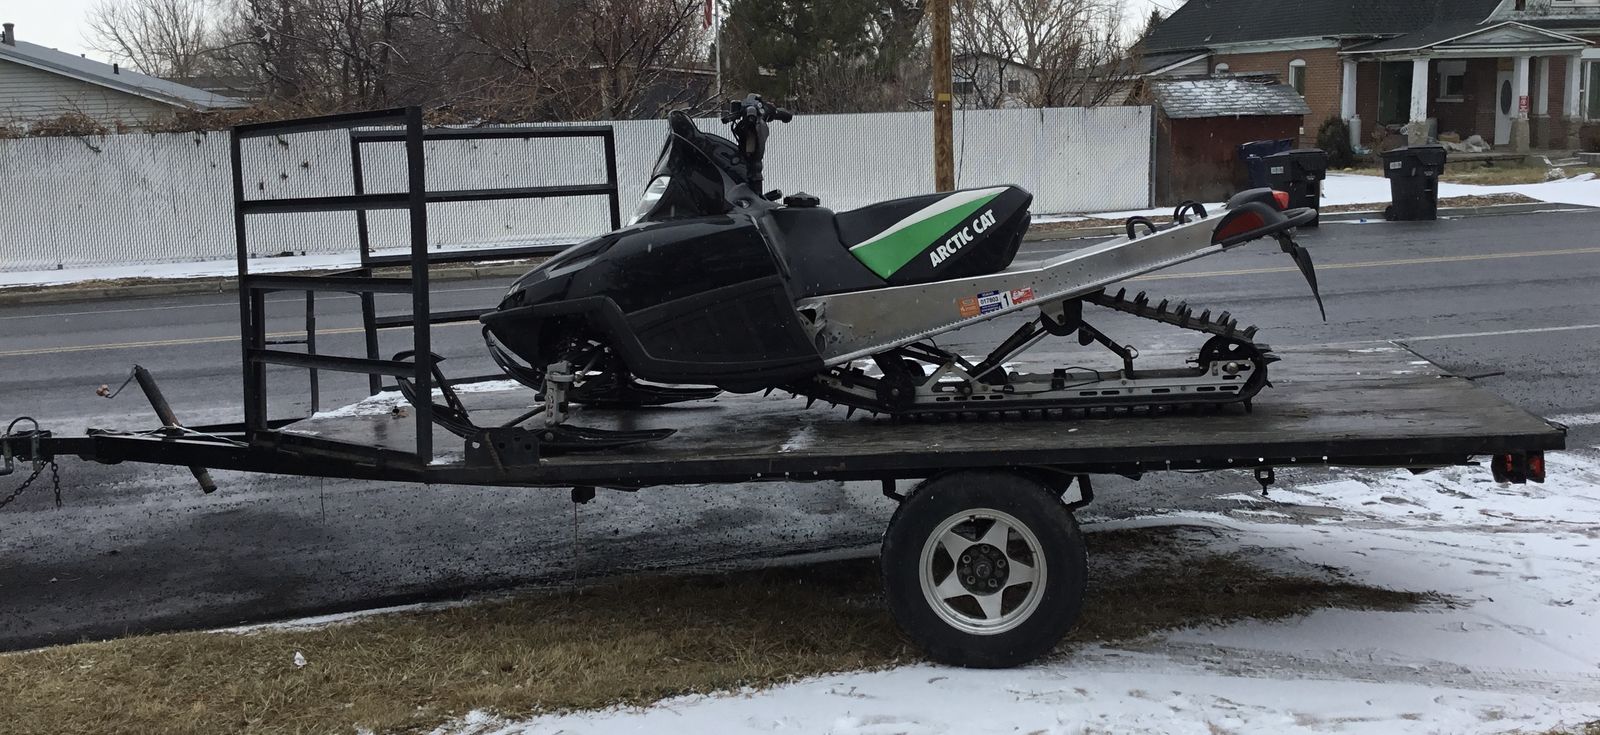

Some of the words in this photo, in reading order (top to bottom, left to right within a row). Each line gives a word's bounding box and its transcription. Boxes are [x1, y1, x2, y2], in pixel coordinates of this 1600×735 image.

[930, 226, 974, 268] ARCTIC
[973, 208, 996, 234] CAT
[1003, 292, 1009, 307] 1
